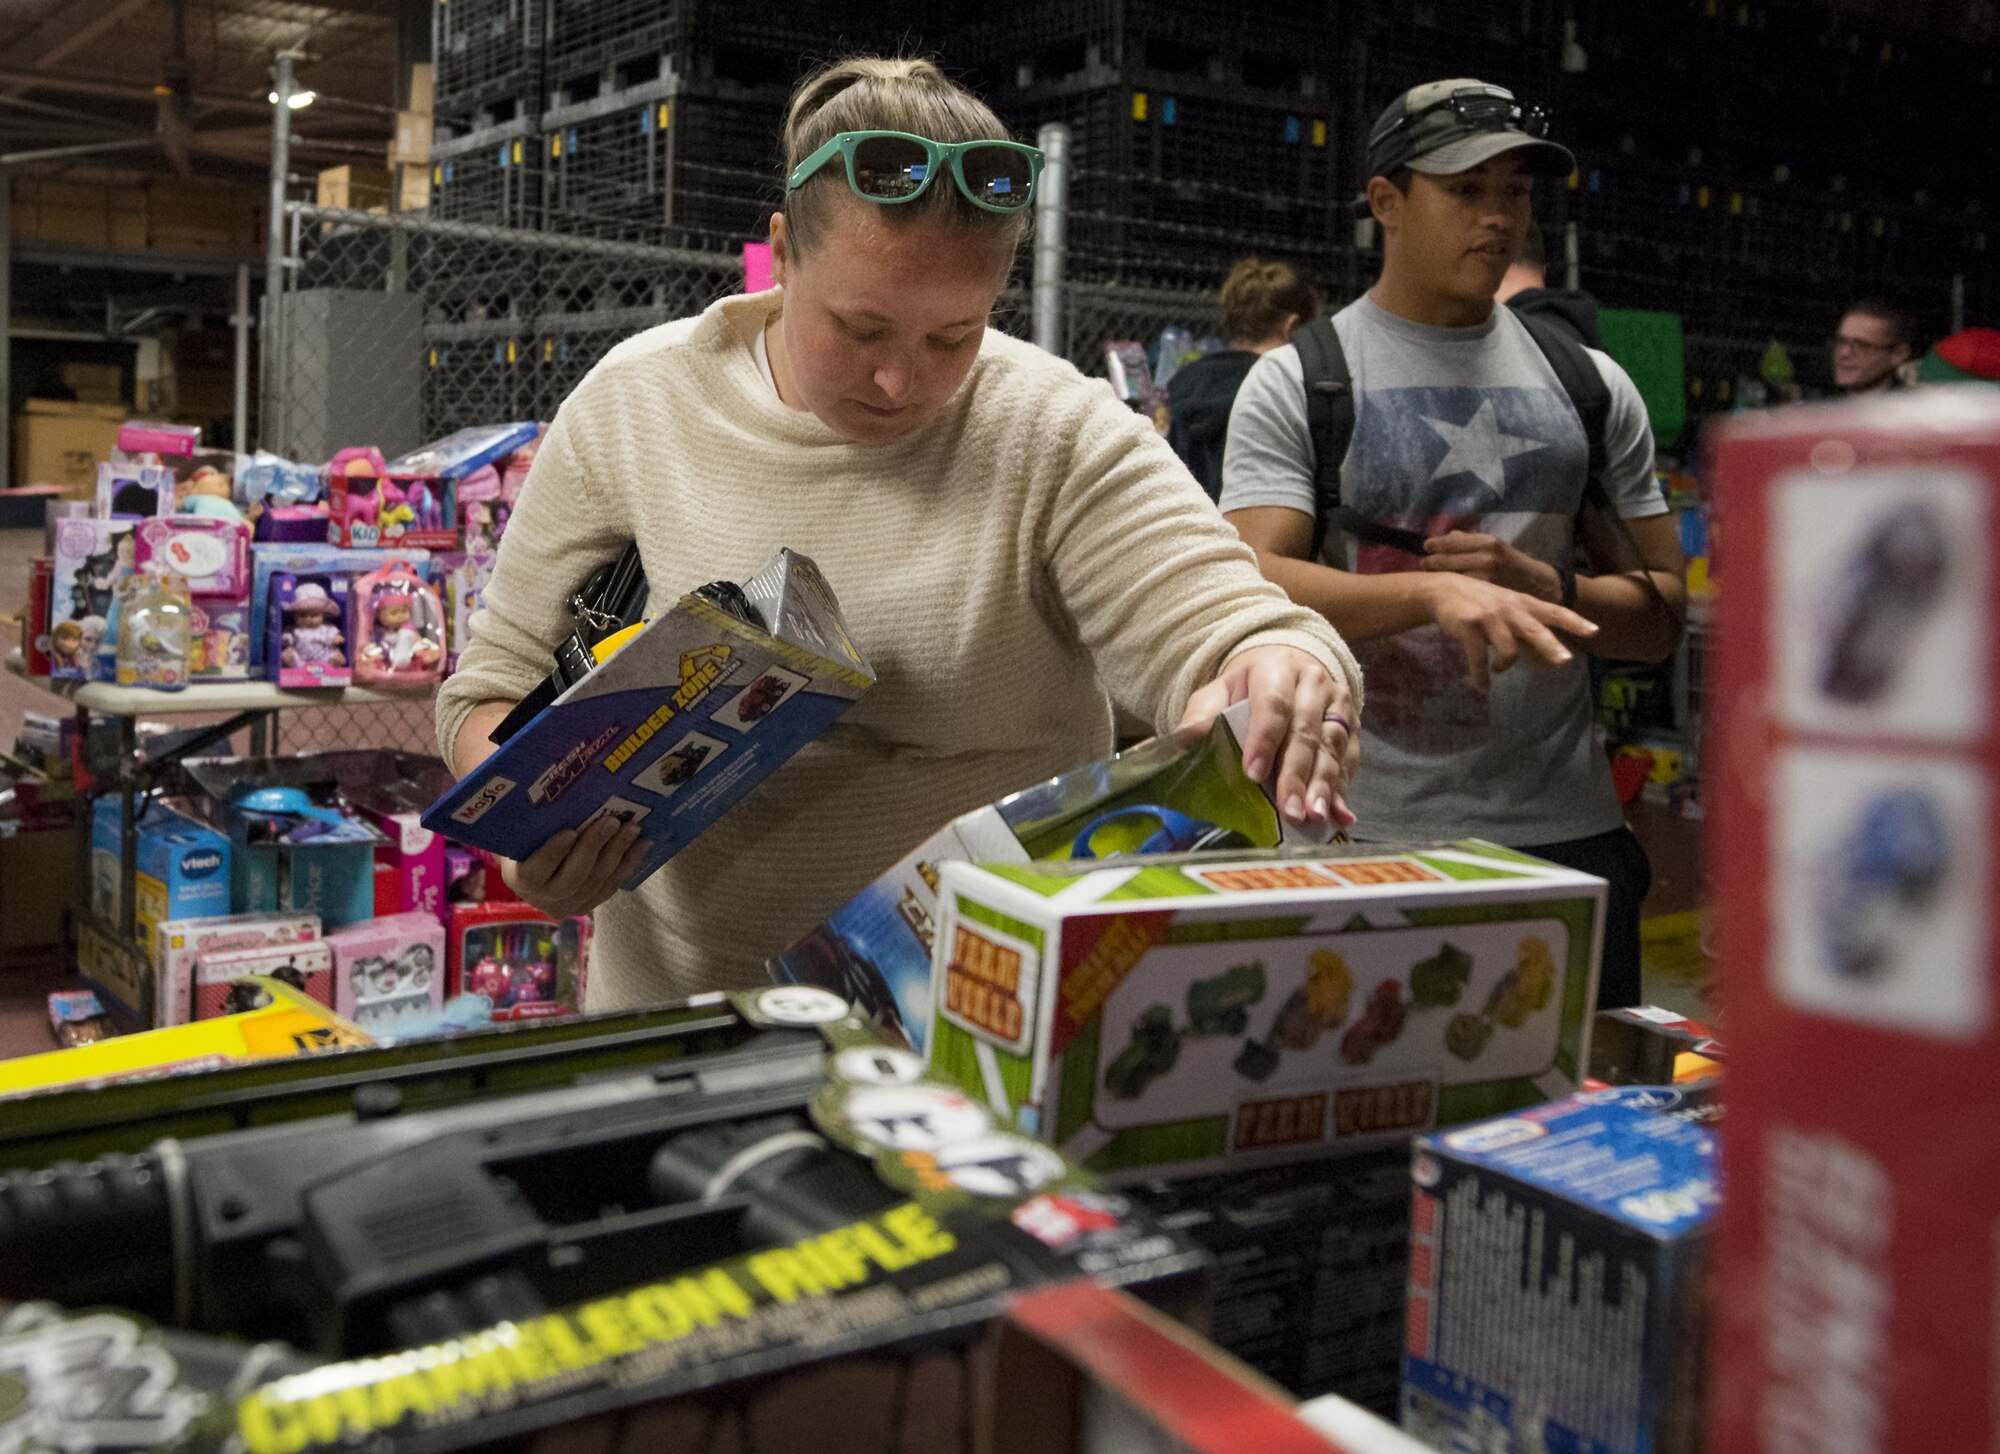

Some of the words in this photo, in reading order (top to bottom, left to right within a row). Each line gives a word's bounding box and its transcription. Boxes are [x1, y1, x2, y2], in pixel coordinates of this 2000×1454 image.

[602, 703, 676, 774] BUILDER
[671, 658, 721, 710] ZONE
[459, 781, 507, 820] Maisto
